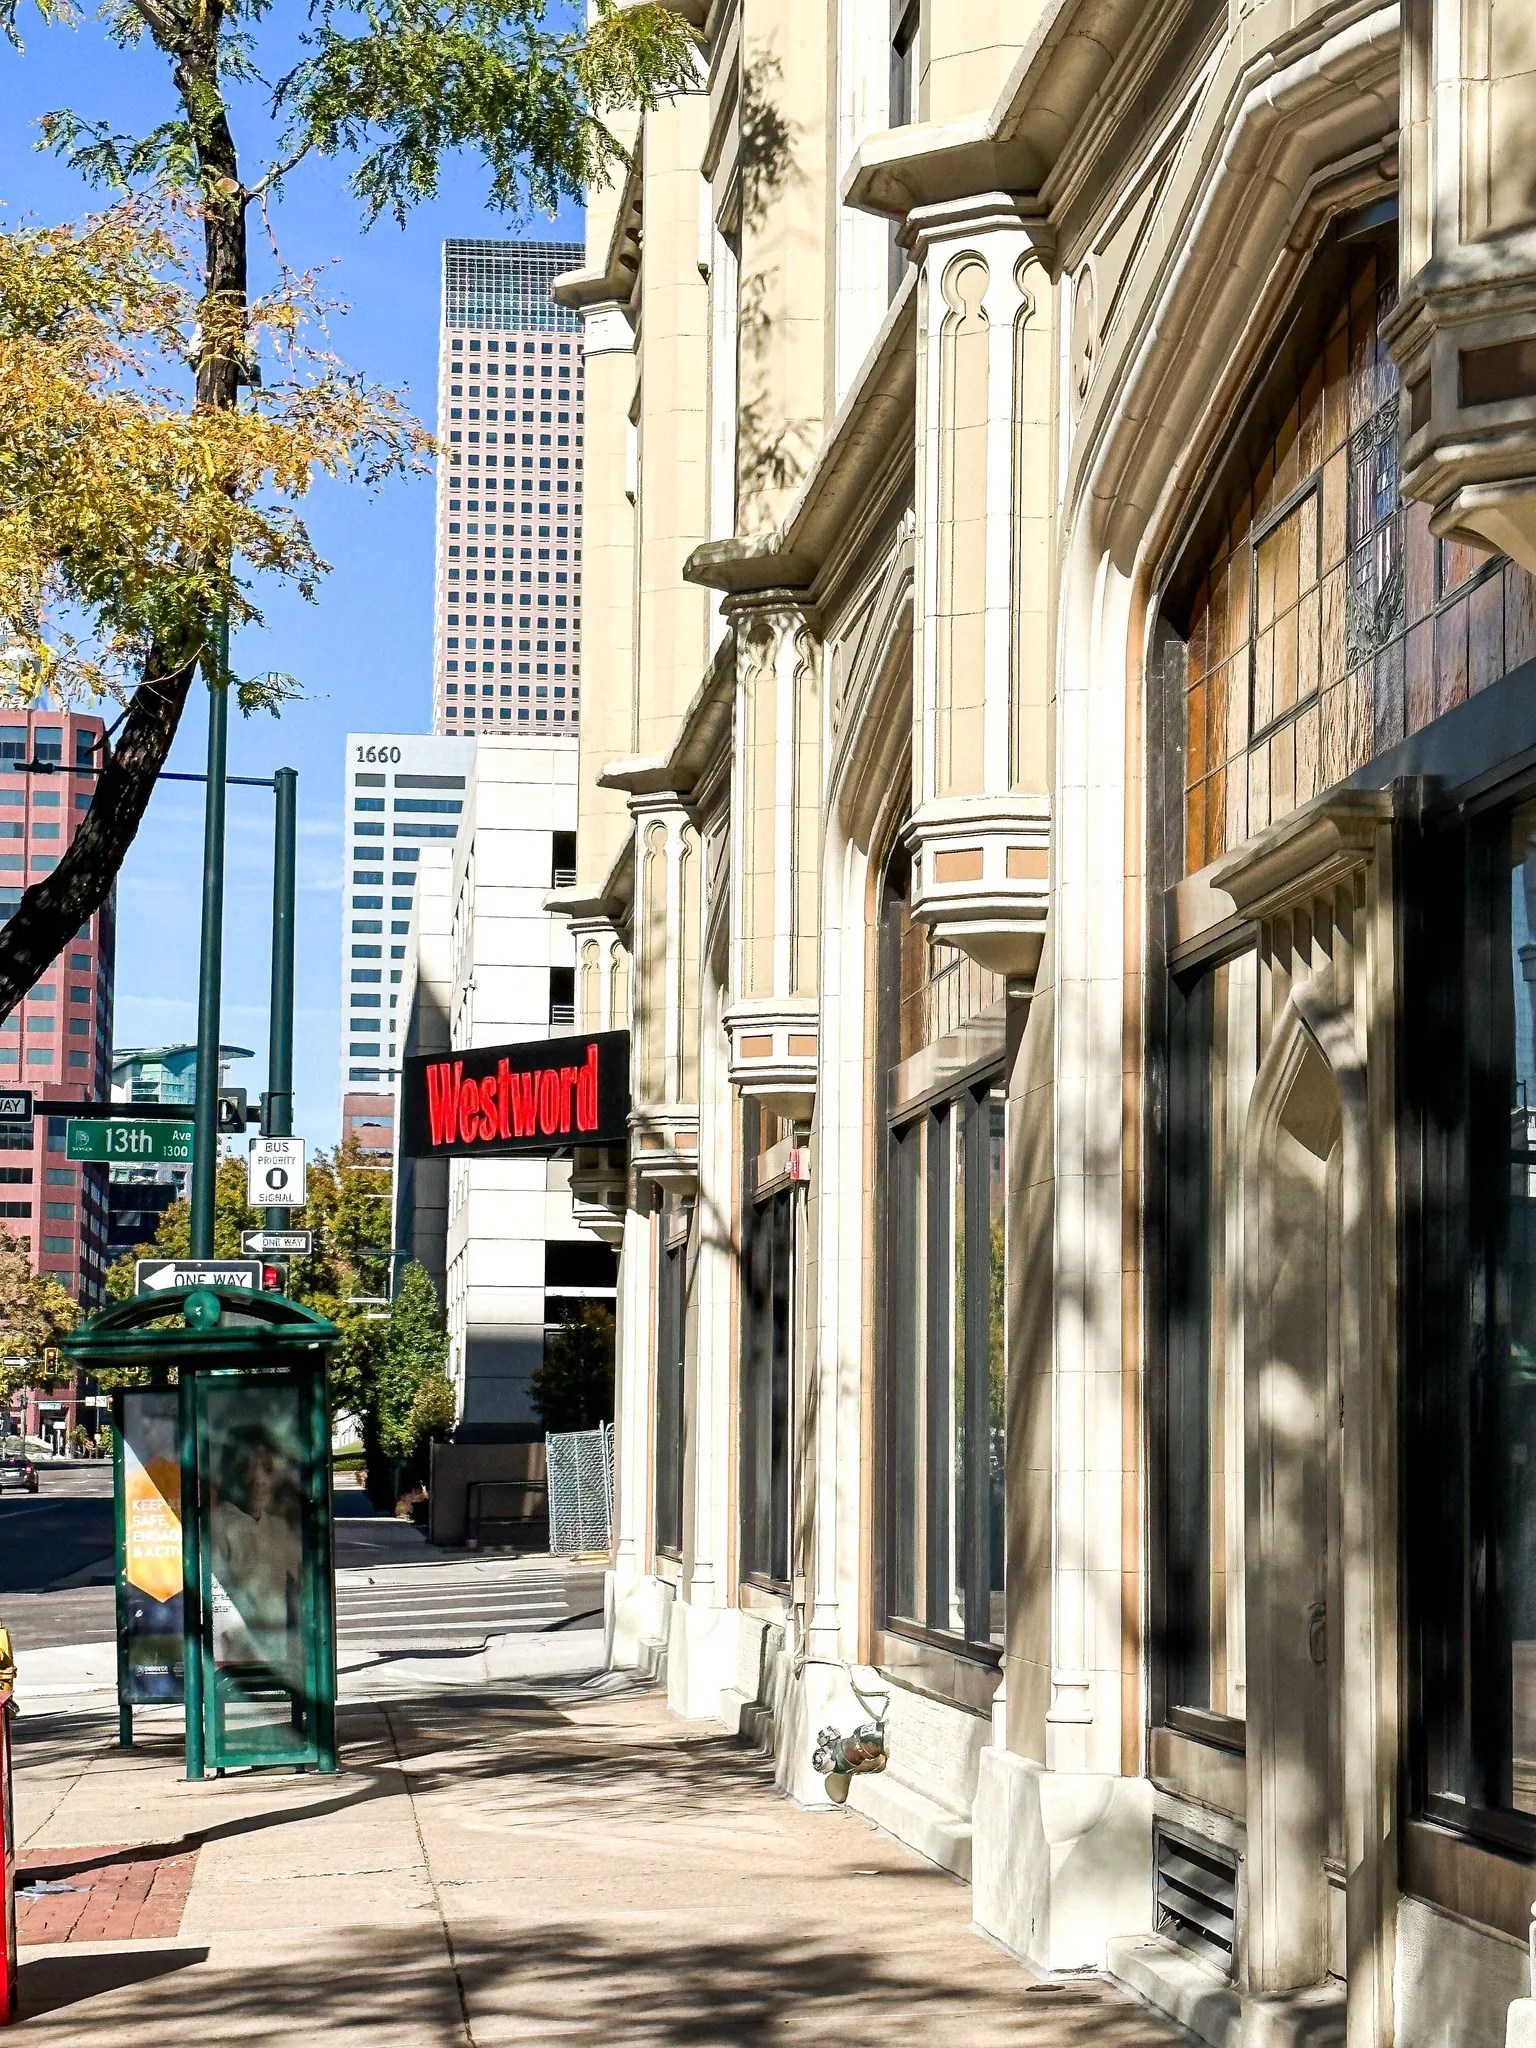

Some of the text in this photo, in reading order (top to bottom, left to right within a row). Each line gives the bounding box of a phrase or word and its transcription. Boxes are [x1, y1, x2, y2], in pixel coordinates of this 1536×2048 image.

[356, 745, 402, 763] 1660
[426, 1043, 598, 1146] Westword
[0, 1099, 20, 1112] AY
[105, 1128, 191, 1153] 13th Ave
[163, 1145, 188, 1157] 1300
[265, 1142, 290, 1153] BUS
[258, 1156, 297, 1165] PRIORITY
[258, 1193, 295, 1202] SIGNAL
[262, 1238, 303, 1247] ONE WAY
[174, 1273, 248, 1287] ONE WAY
[132, 1499, 164, 1511] KEEP
